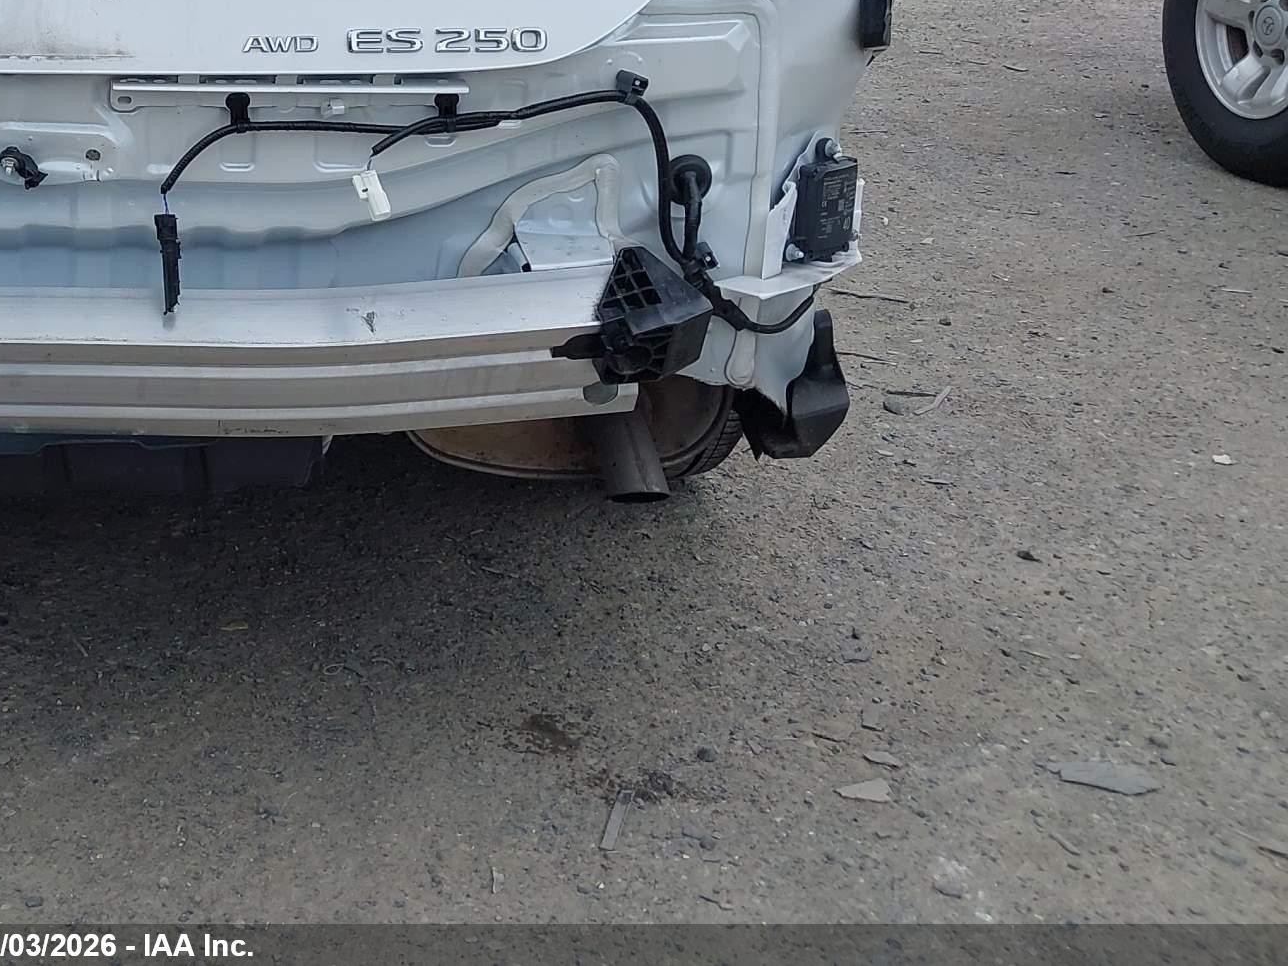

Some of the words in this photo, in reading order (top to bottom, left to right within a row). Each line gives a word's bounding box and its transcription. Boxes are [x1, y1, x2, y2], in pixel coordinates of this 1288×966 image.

[242, 35, 319, 53] AWD
[346, 27, 423, 54] ES
[435, 27, 548, 54] 250
